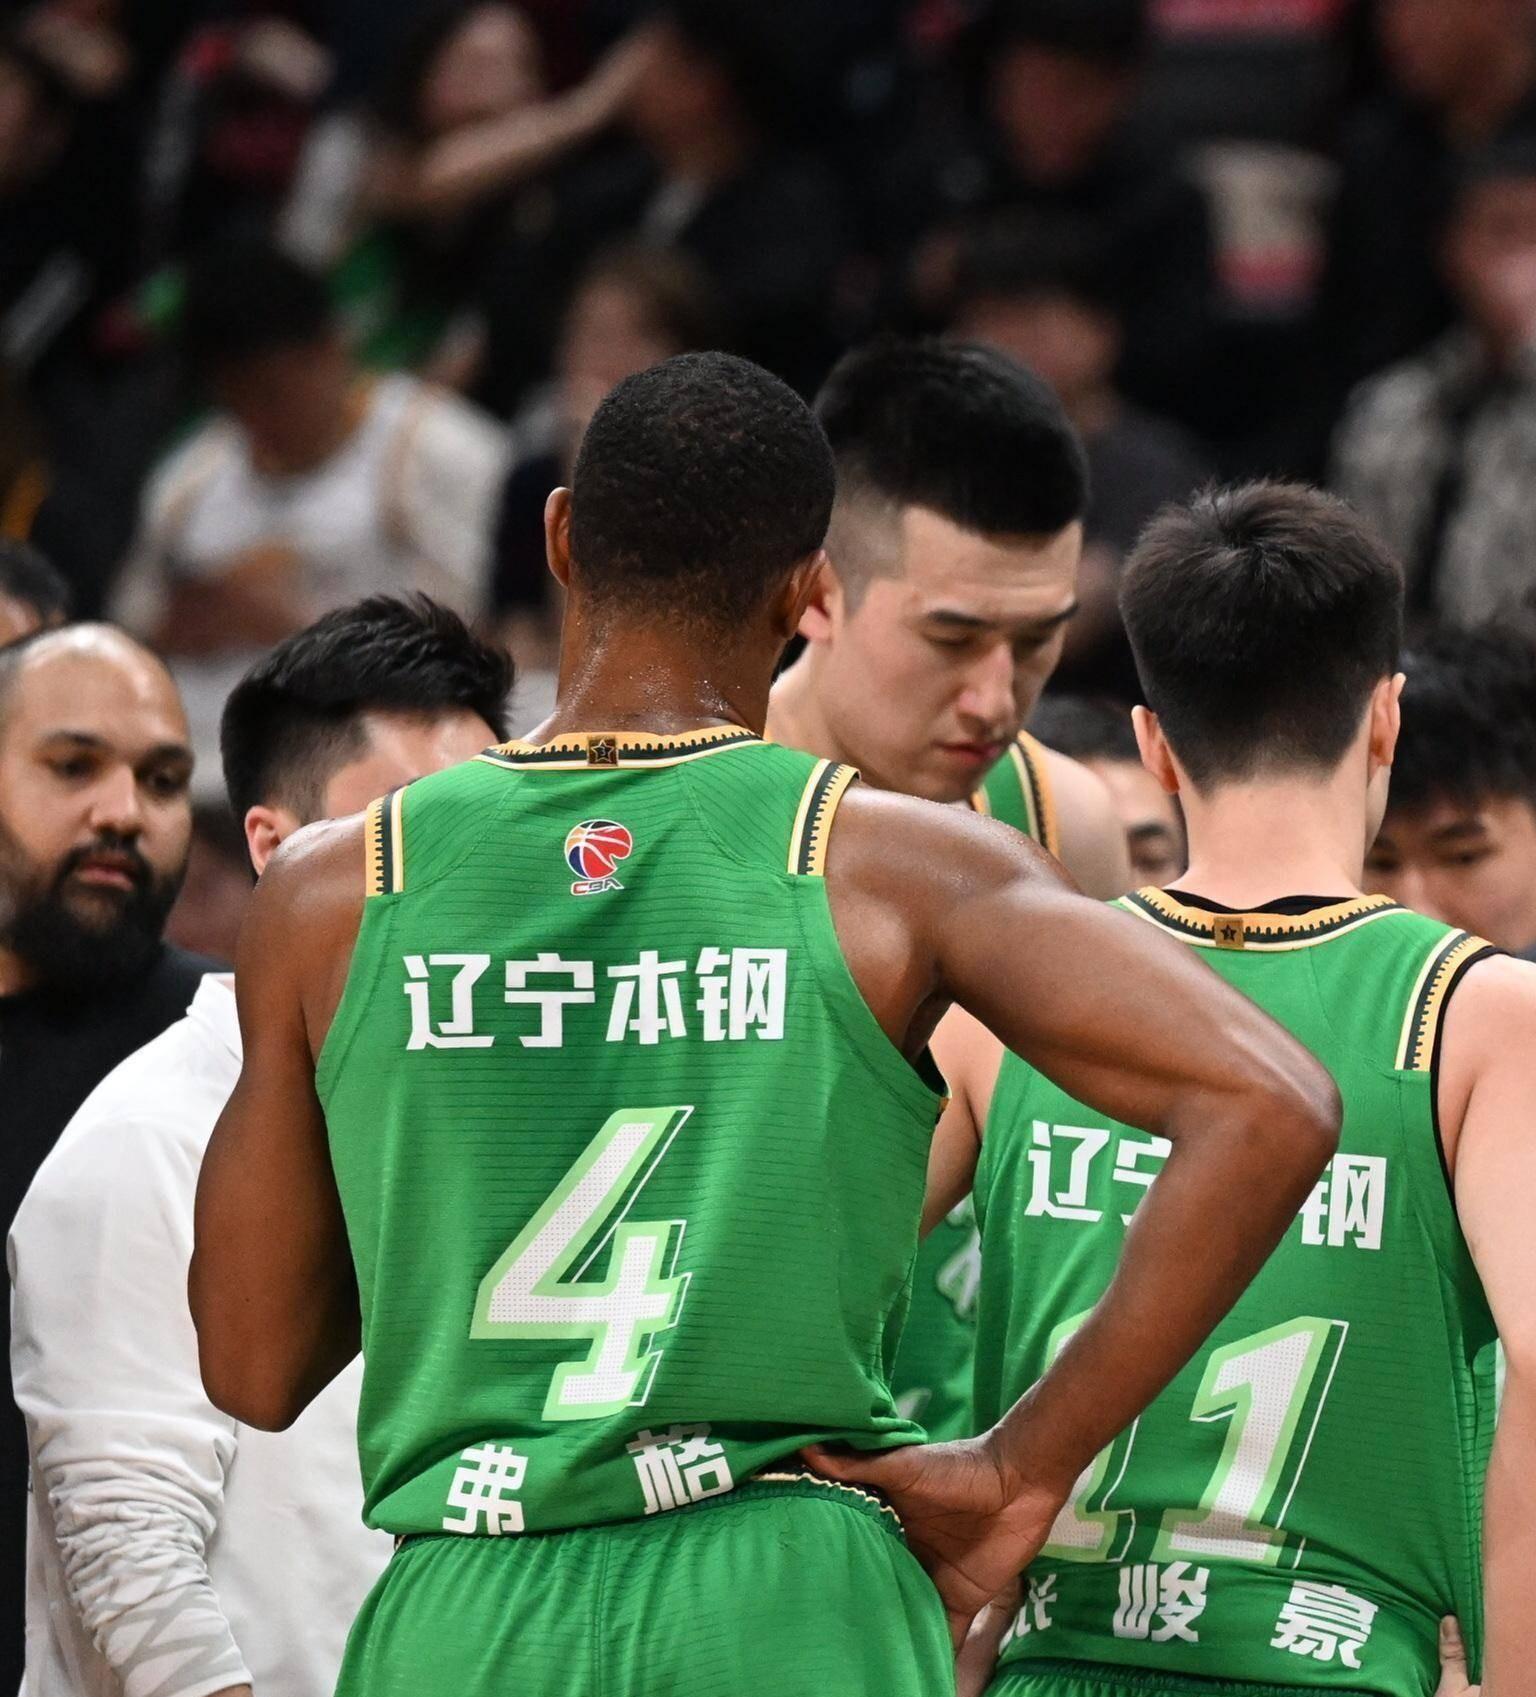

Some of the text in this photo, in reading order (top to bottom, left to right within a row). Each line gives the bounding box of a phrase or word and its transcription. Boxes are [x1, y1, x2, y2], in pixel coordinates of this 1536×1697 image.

[570, 876, 625, 896] CBA
[403, 946, 788, 1050] 辽宁本钢
[469, 1105, 695, 1422] 4
[442, 1422, 735, 1535] 弗格
